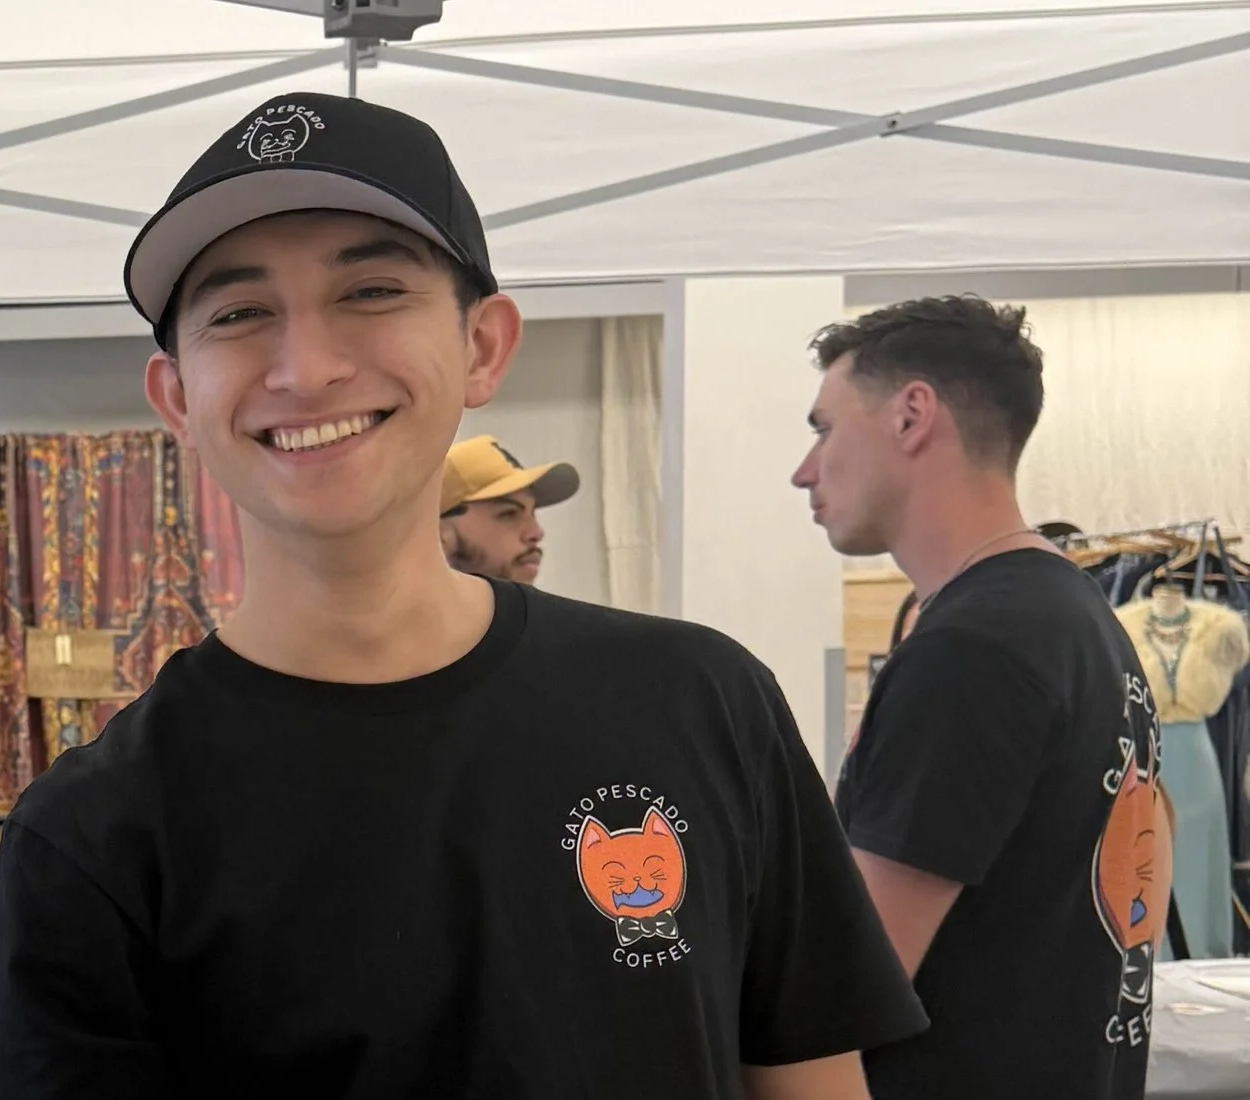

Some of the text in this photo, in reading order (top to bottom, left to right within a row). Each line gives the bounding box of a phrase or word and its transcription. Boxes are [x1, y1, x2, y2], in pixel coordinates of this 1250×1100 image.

[561, 784, 689, 850] GATO PESCADO
[613, 938, 691, 968] COFFEE
